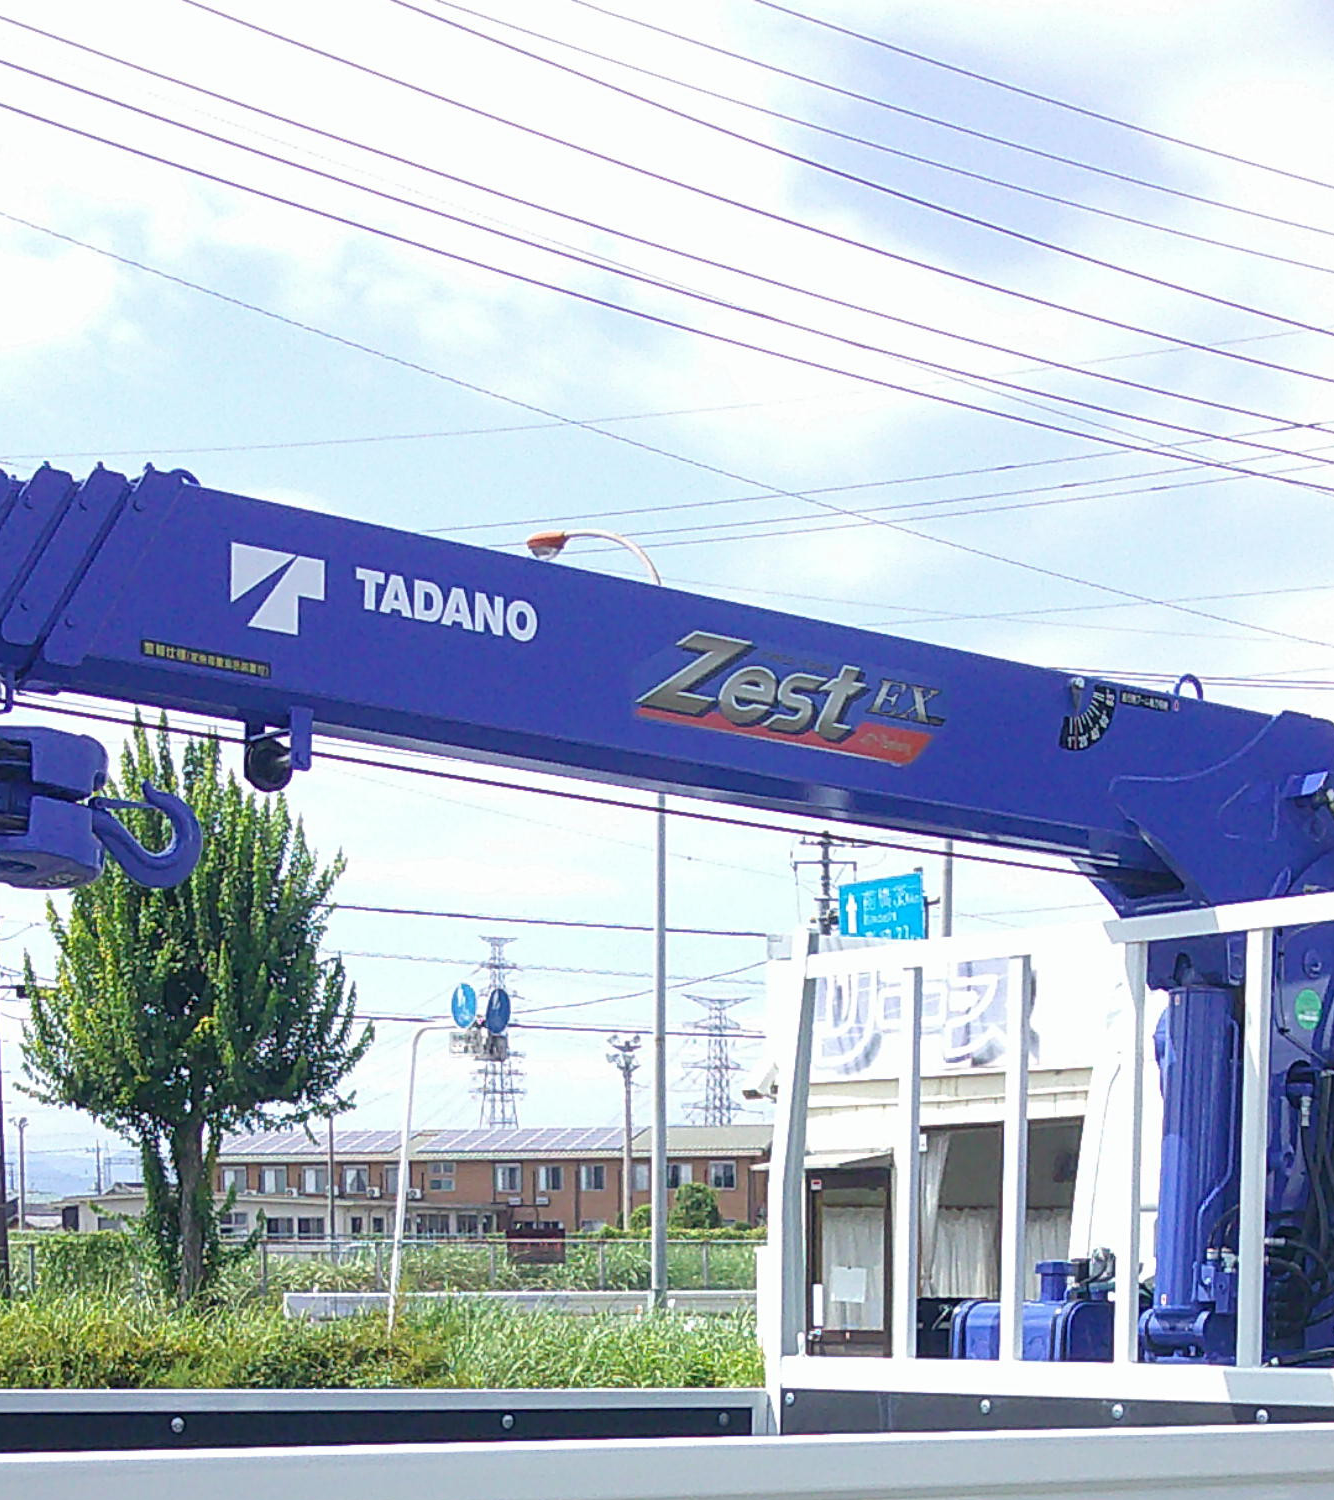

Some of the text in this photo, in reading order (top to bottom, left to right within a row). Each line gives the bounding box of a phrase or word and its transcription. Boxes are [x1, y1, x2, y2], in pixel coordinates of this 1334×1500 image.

[355, 566, 538, 642] TADANO
[634, 630, 946, 743] Zest EX
